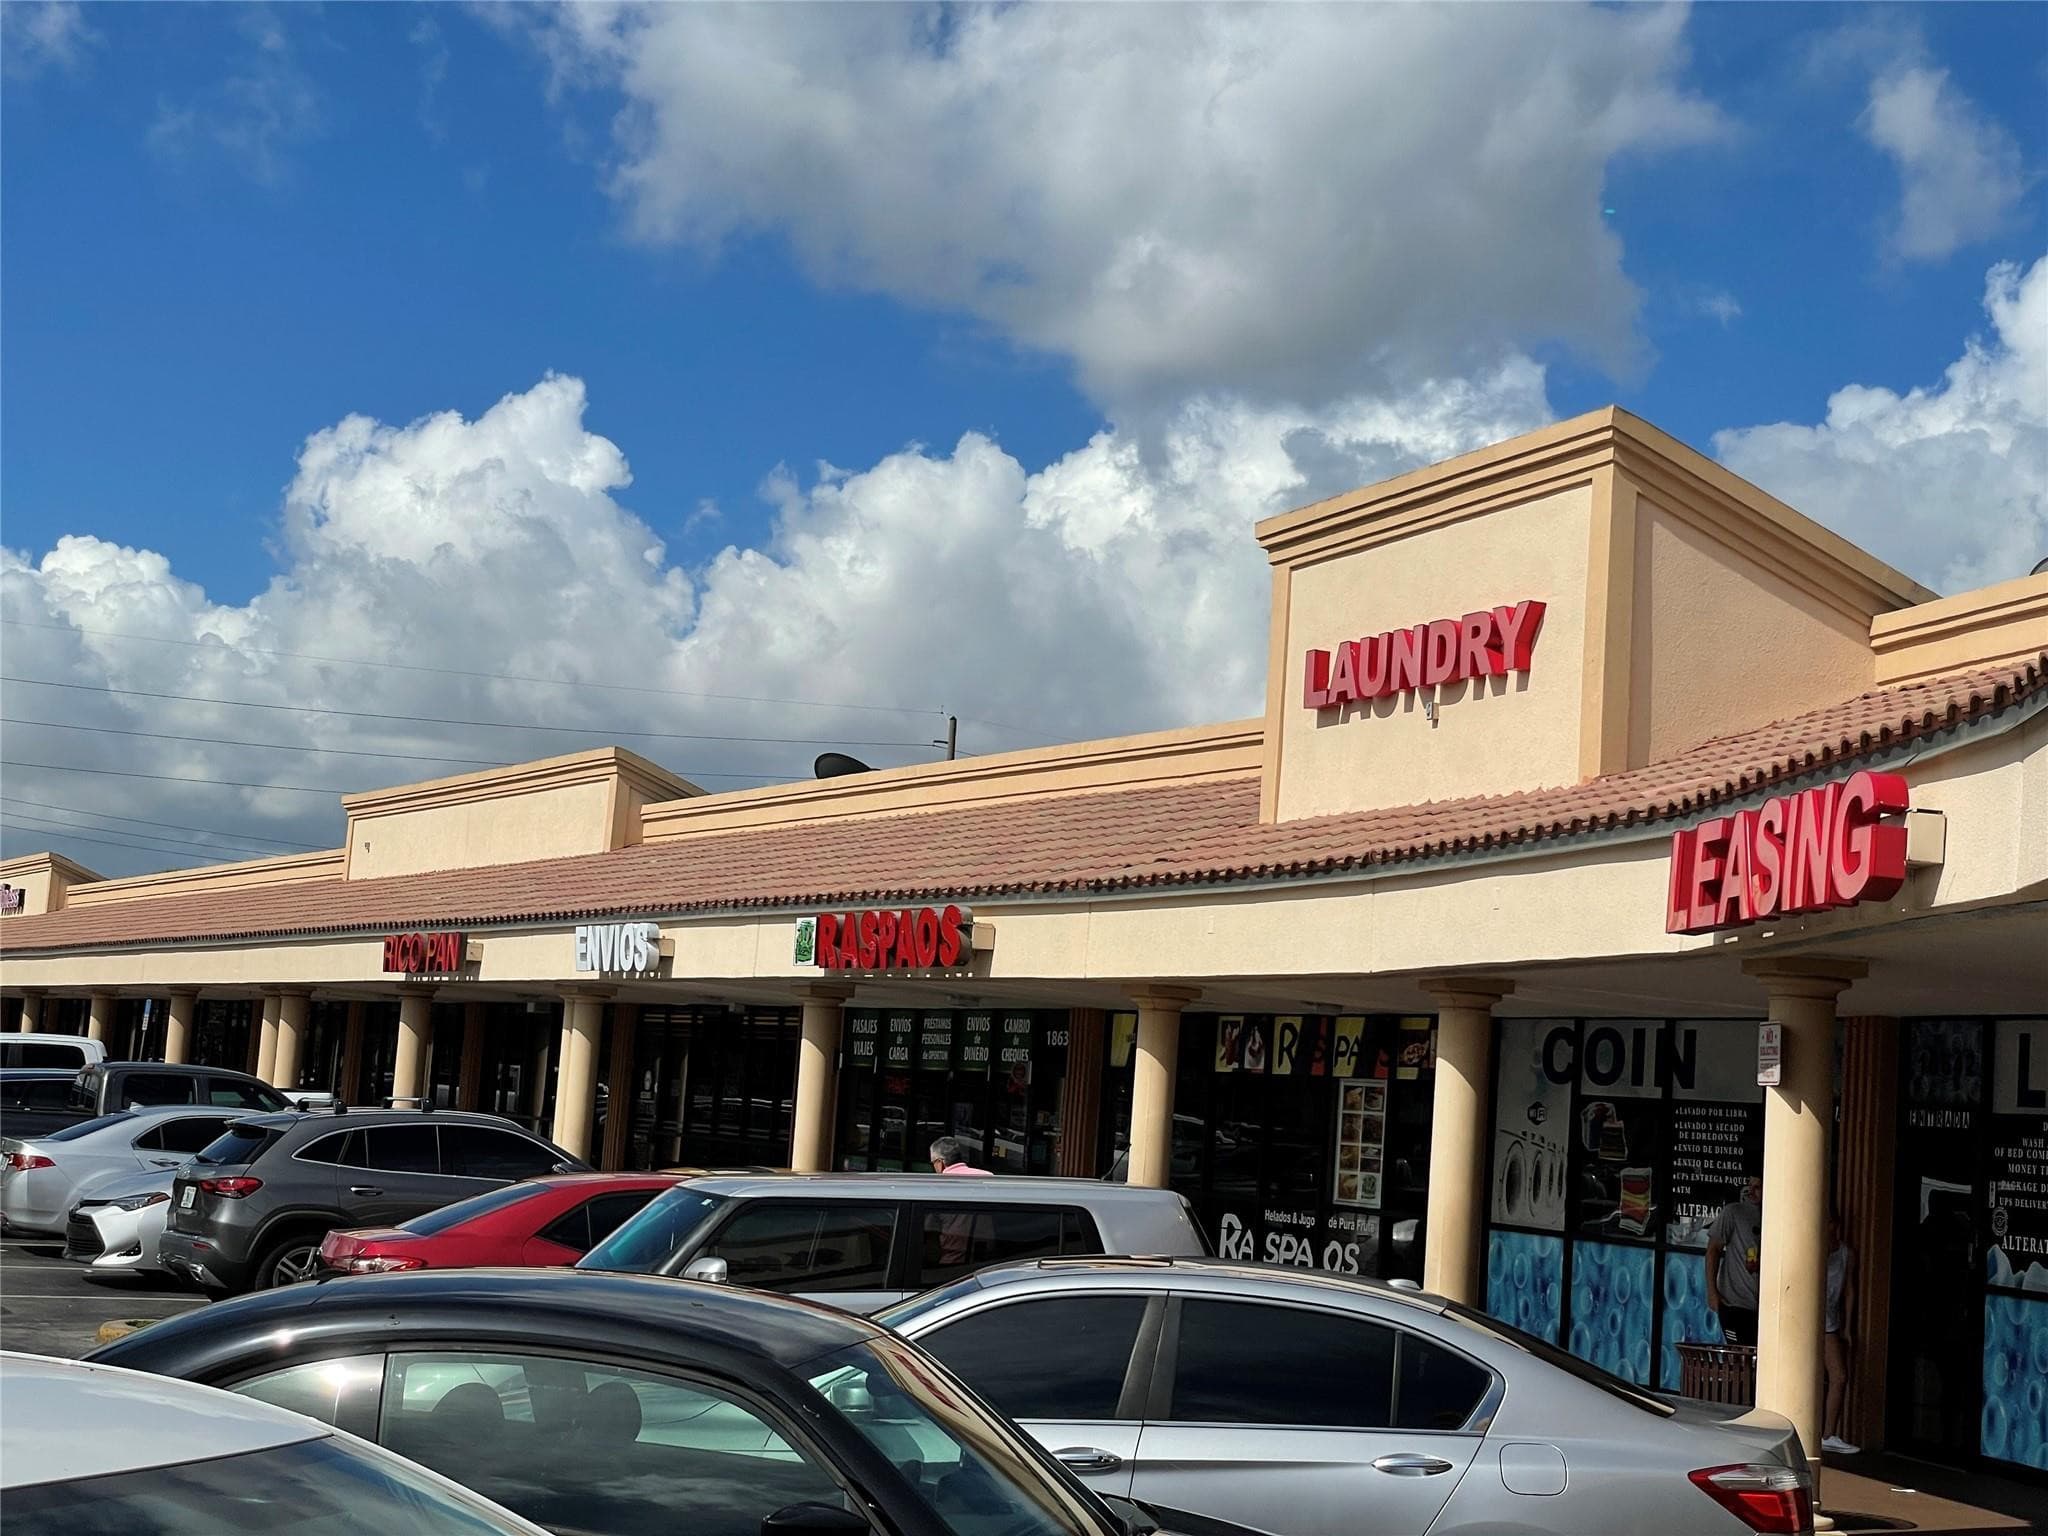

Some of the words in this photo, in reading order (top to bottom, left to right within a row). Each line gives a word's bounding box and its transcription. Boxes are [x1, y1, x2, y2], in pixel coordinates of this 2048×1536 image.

[1304, 600, 1546, 709] LAUNDRY
[1666, 771, 1908, 935] LEASING
[817, 905, 968, 970] RASPAOS
[383, 933, 424, 973] RICO
[426, 932, 461, 972] PAN
[576, 923, 659, 972] ENVIOS
[852, 1019, 878, 1034] PASAJES
[1004, 1019, 1031, 1033] CAMBIO
[1046, 1031, 1070, 1046] 1863
[853, 1041, 874, 1056] VIAJES
[889, 1047, 909, 1060] CARGA
[964, 1046, 989, 1061] DINERO
[1001, 1048, 1029, 1062] CHEQUES
[1543, 1027, 1697, 1089] COIN
[1679, 1107, 1706, 1116] LAVADO
[1708, 1108, 1723, 1117] POR
[1725, 1109, 1747, 1118] LIBRA
[1679, 1121, 1706, 1130] LAVADO
[1715, 1123, 1745, 1132] SECADO
[1679, 1131, 1688, 1139] DE
[1703, 1145, 1712, 1154] DE
[1714, 1146, 1744, 1155] DINERO
[2022, 1138, 2044, 1148] WASH
[1994, 1147, 2005, 1158] OF
[2008, 1148, 2024, 1159] BED
[1704, 1160, 1714, 1168] DE
[1716, 1161, 1742, 1170] CARGA
[2008, 1163, 2037, 1175] MONEY
[1691, 1173, 1722, 1183] ENTREGA
[1724, 1176, 1750, 1186] PAQUE
[2001, 1180, 2038, 1193] PACKAGE
[1676, 1186, 1691, 1194] ATM
[1676, 1202, 1724, 1219] ALTERAC
[1264, 1209, 1291, 1224] Helados
[1292, 1212, 1298, 1224] &
[1299, 1213, 1316, 1228] Jugo
[1328, 1216, 1338, 1229] de
[1339, 1218, 1355, 1230] Pura
[1263, 1232, 1314, 1268] SPA
